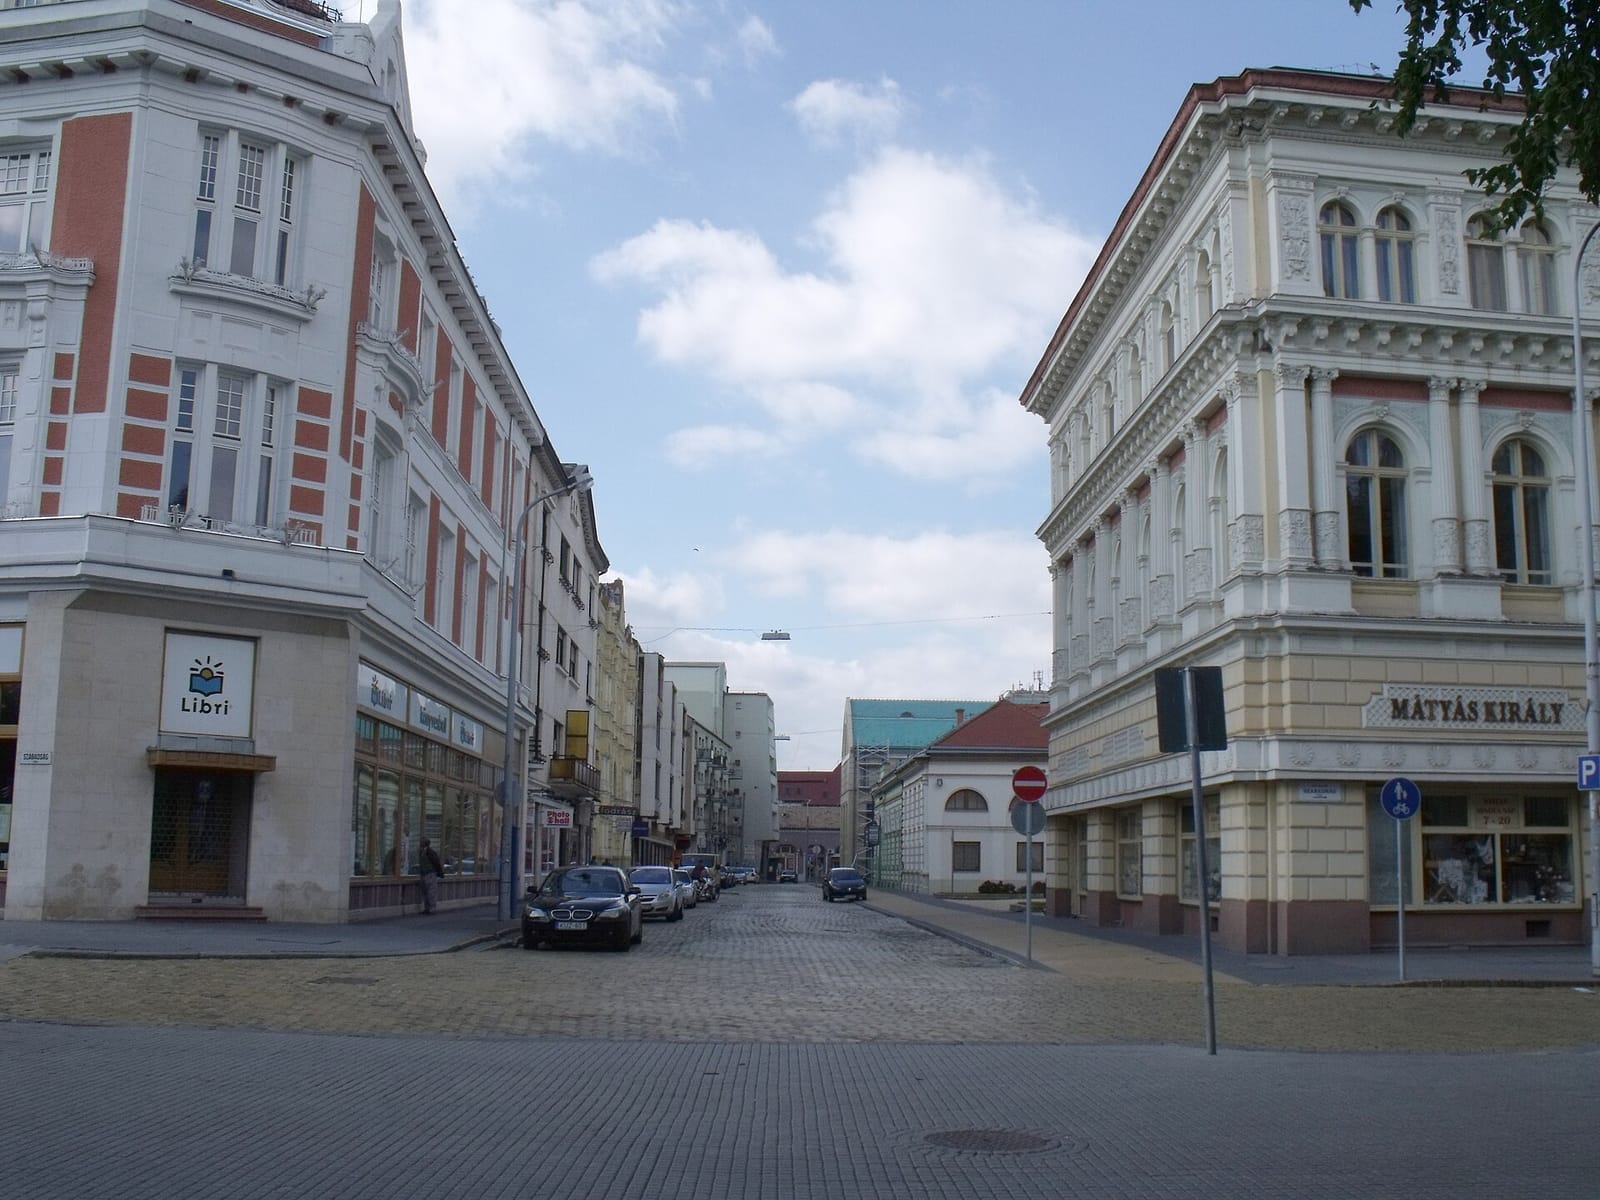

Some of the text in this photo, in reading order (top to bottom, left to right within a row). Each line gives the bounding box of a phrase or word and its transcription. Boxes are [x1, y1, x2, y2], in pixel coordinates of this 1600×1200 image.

[181, 697, 229, 715] Libri
[1390, 695, 1565, 724] MÁTYÁS KIRÁLY
[1581, 760, 1596, 785] P
[547, 810, 570, 819] Photo
[1498, 815, 1511, 825] 20
